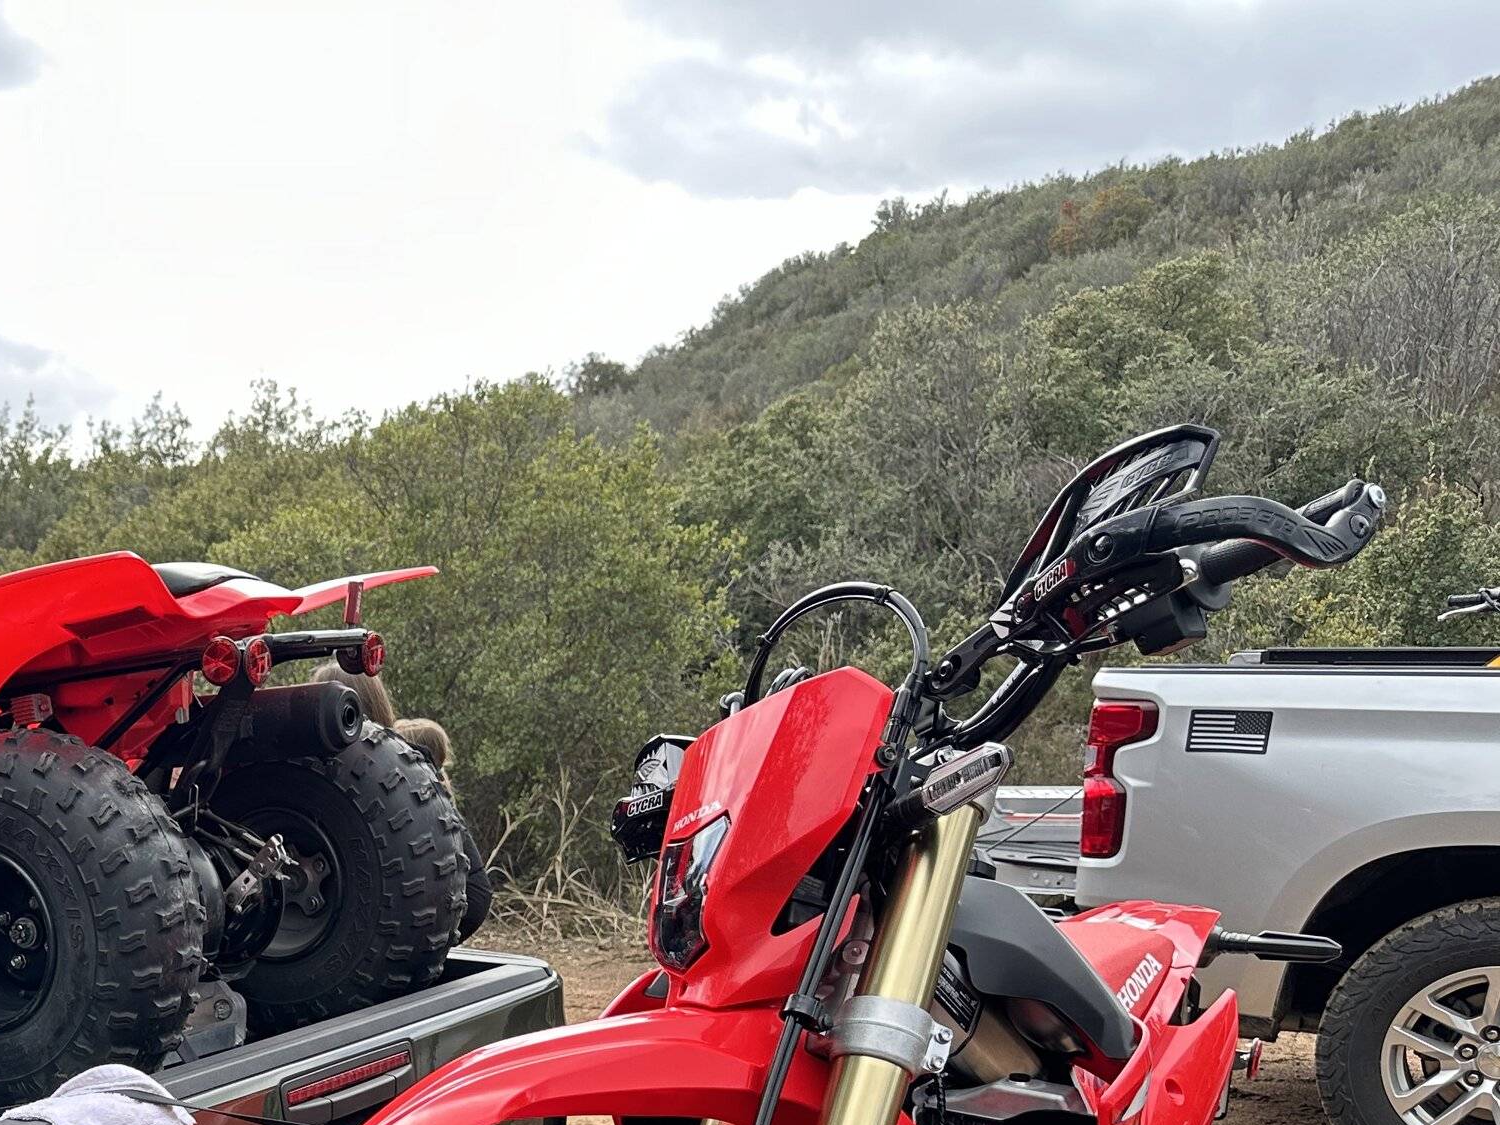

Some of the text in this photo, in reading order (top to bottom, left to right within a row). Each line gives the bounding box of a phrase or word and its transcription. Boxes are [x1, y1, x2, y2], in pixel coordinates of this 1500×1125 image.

[1033, 558, 1068, 601] CYCRA
[626, 792, 663, 818] CYCRA
[671, 800, 722, 834] HONDA
[1116, 952, 1163, 1014] HONDA
